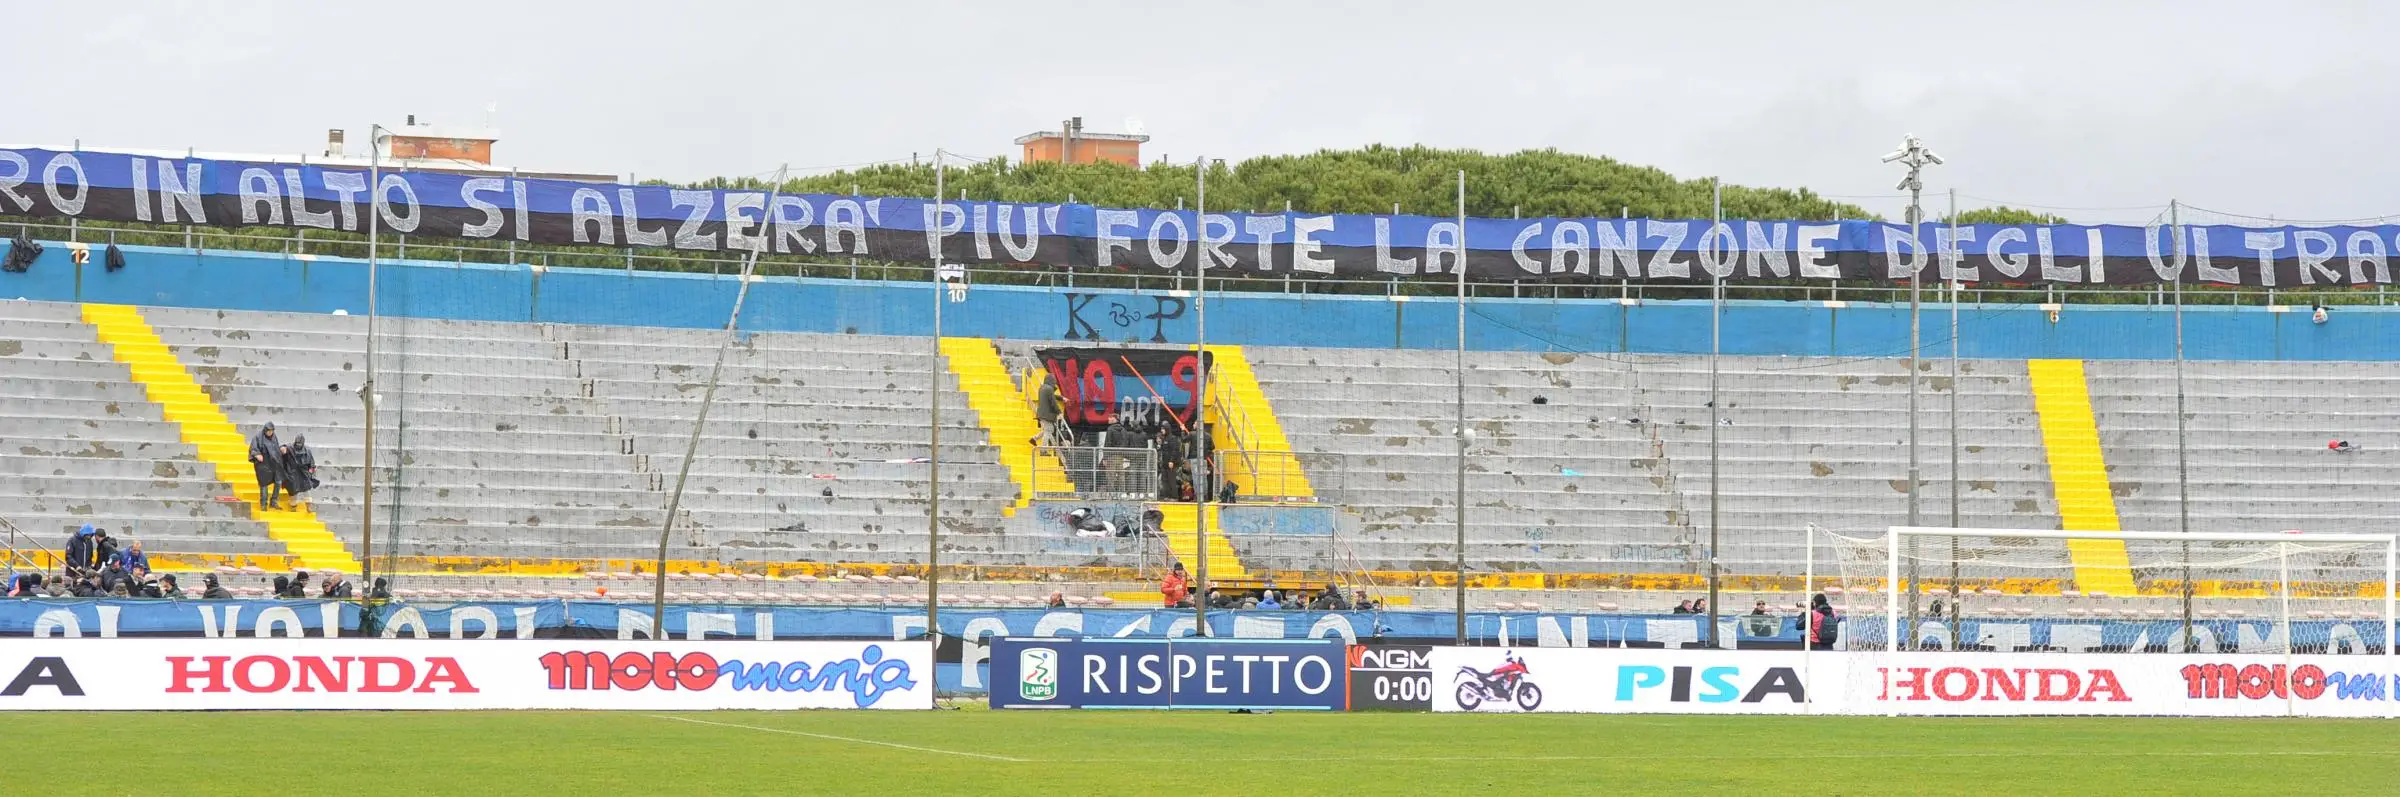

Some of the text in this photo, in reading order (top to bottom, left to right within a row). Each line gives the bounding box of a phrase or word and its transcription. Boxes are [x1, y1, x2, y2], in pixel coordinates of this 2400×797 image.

[131, 157, 207, 224] IN
[240, 167, 420, 233] ALTO
[460, 178, 530, 240] SI
[571, 187, 883, 256] ALZERA'
[923, 202, 1061, 262] PIU'
[1096, 208, 1336, 275] FORTE
[1374, 216, 1466, 275] LA
[1511, 218, 1842, 279] CANZONE
[1882, 223, 2106, 284] DEGLI
[2145, 222, 2400, 286] ULTRA
[71, 249, 90, 264] 12
[947, 289, 966, 303] 10
[1064, 293, 1106, 340] K
[1144, 295, 1186, 343] P
[1047, 355, 1200, 427] NO ART 9
[165, 655, 480, 694] HONDA
[1082, 653, 1333, 696] RISPETTO
[1360, 649, 1432, 669] NGM
[1025, 685, 1052, 696] LNPB
[1374, 676, 1432, 701] 0:00
[1615, 665, 1812, 704] PISA
[1877, 666, 2133, 702] HONDA
